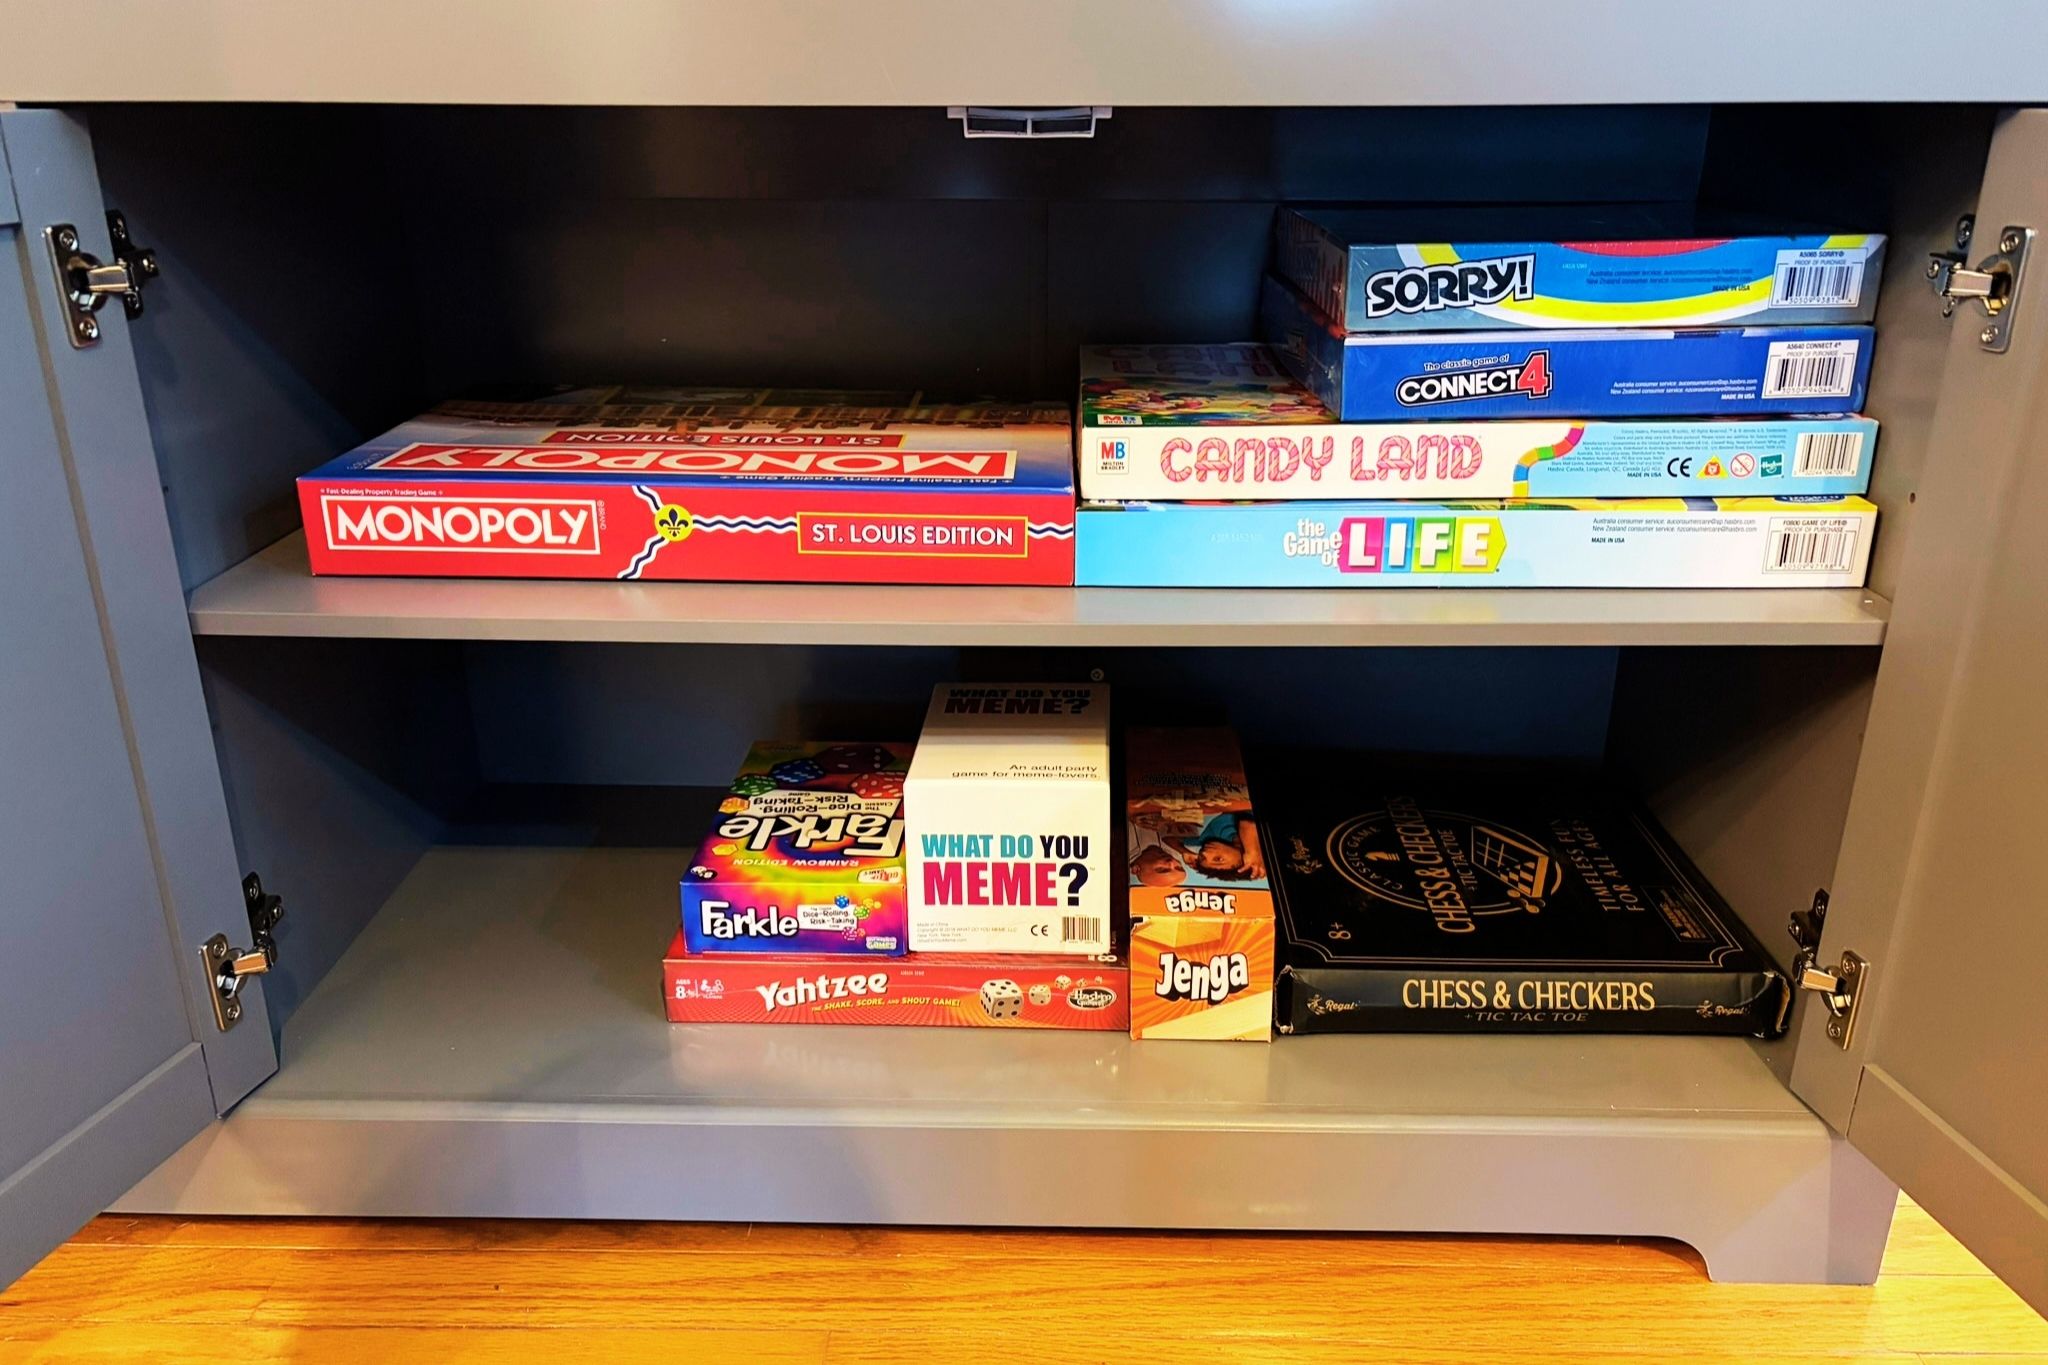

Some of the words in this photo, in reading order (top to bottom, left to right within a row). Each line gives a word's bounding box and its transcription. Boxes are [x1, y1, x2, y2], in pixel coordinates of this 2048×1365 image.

[1369, 258, 1530, 312] SORRY!
[1424, 362, 1440, 371] The
[1441, 359, 1471, 370] classic
[1472, 357, 1498, 368] game
[1499, 353, 1510, 363] of
[1400, 368, 1520, 402] CONNECT
[1517, 354, 1549, 395] 4
[567, 433, 717, 444] EDITION
[719, 435, 823, 445] LOUIS
[841, 437, 883, 446] ST.
[1101, 441, 1126, 460] MB
[1160, 436, 1334, 482] CANDY
[1350, 434, 1483, 481] LAND
[397, 448, 992, 475] MONOPOLY
[365, 488, 392, 497] Property
[336, 503, 589, 545] MONOPOLY
[1297, 518, 1325, 538] the
[812, 524, 844, 544] ST.
[850, 524, 917, 545] LOUIS
[922, 526, 1014, 547] EDITION
[1283, 531, 1343, 557] Game
[1348, 522, 1491, 567] LIFE
[1321, 549, 1340, 568] of
[950, 689, 1011, 698] WHAT
[1015, 689, 1044, 698] DO
[1050, 689, 1091, 698] YOU
[944, 698, 1091, 714] MEME?
[1065, 764, 1098, 772] party
[753, 795, 849, 806] Risk-Taking
[718, 814, 905, 857] Farkle
[921, 834, 994, 858] WHAT
[1000, 834, 1034, 859] DO
[1039, 835, 1089, 860] YOU
[732, 858, 789, 866] EDITION
[792, 859, 860, 867] RAINBOW
[1446, 849, 1470, 868] TAC
[1593, 855, 1623, 879] ALL
[1347, 850, 1404, 891] CLASSIC
[1413, 866, 1452, 879] &
[1566, 848, 1622, 912] TIMELESS
[923, 861, 1089, 907] MEME?
[1164, 890, 1237, 914] Jenga
[1419, 880, 1476, 934] CHESS
[1612, 884, 1646, 912] FOR
[700, 900, 799, 939] Farkle
[809, 917, 856, 926] Risk-Taking
[1327, 921, 1352, 940] 8+
[1154, 952, 1249, 1004] Jenga
[756, 973, 888, 1012] Yahtzee
[1073, 989, 1113, 1001] Hasbro
[1402, 979, 1486, 1009] CHESS
[1493, 980, 1512, 1010] &
[1518, 980, 1656, 1011] CHECKERS
[823, 1001, 855, 1011] SHAKE,
[856, 998, 885, 1007] SCORE,
[901, 997, 931, 1005] SHOUT
[933, 997, 960, 1007] GAME!
[1325, 1000, 1356, 1011] Regal
[1714, 1005, 1745, 1016] Regal
[1509, 1011, 1548, 1022] TAC
[1551, 1011, 1589, 1022] TOE
